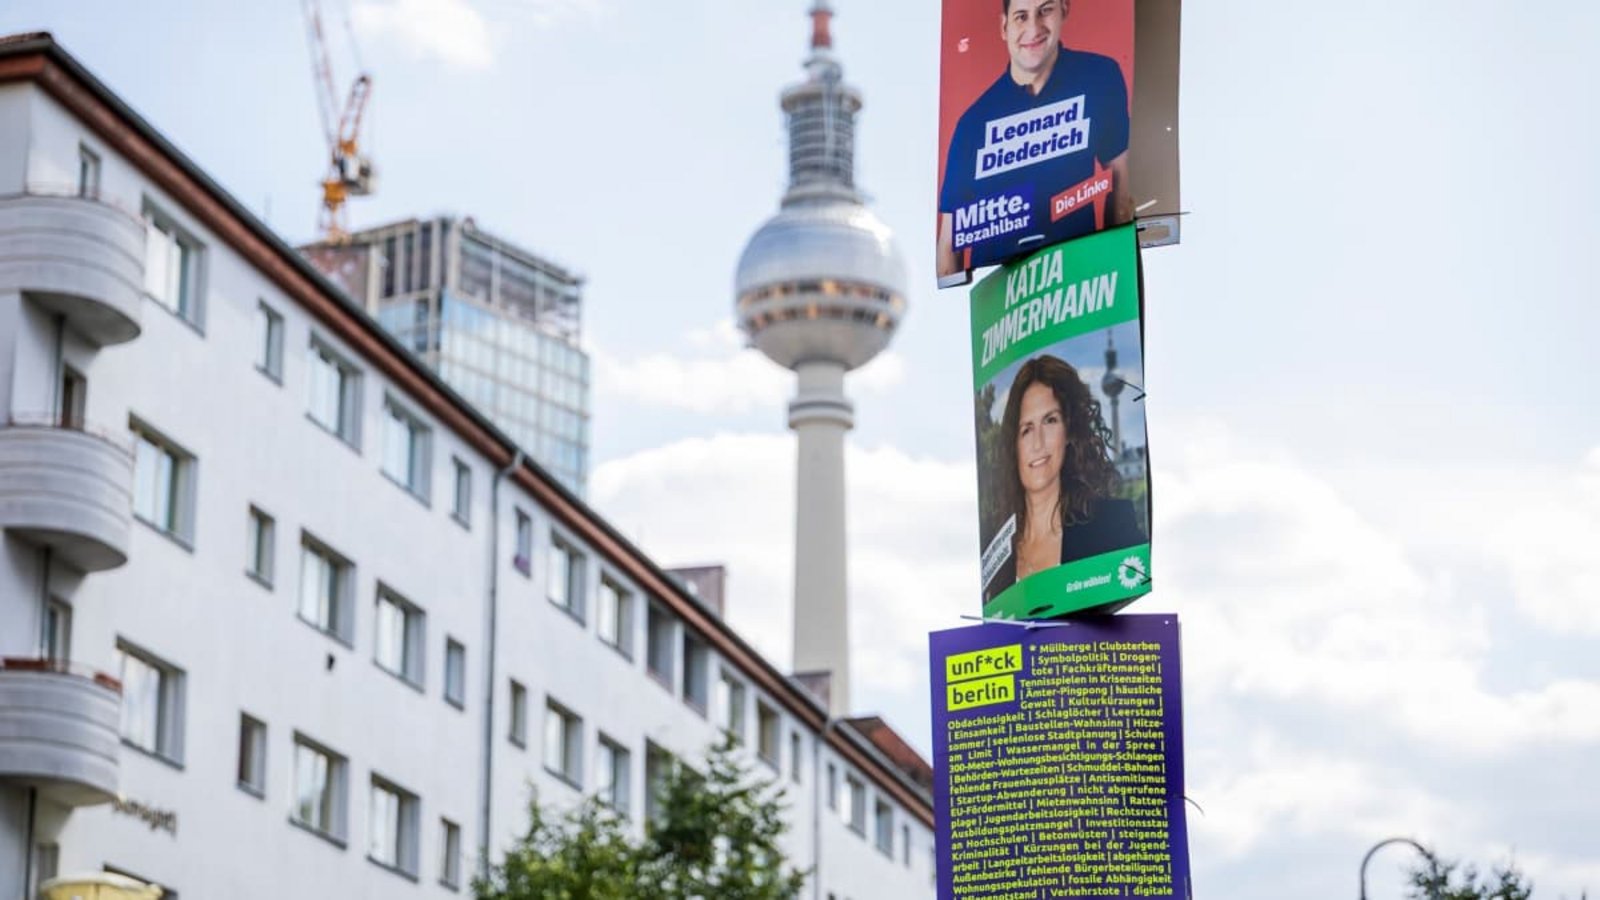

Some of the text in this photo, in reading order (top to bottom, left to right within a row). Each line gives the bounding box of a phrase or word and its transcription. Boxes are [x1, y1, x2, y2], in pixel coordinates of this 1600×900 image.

[991, 102, 1078, 144] Leonard
[982, 128, 1083, 172] Diederich
[1056, 179, 1109, 214] Die Linke
[956, 195, 1030, 231] Mitte.
[956, 216, 1030, 248] Bezahlbar
[1005, 250, 1063, 310] KATJA
[982, 271, 1118, 368] ZIMMERMANN
[1040, 642, 1091, 653] Müllberge
[1100, 641, 1160, 650] Clubsterben
[1120, 653, 1160, 663] Drogen-
[1032, 667, 1053, 676] tote
[1089, 674, 1098, 682] in
[1100, 673, 1162, 683] Krisenzeiten
[954, 682, 1008, 704] berlin
[1116, 684, 1162, 694] häusliche
[1021, 698, 1056, 709] Gewalt
[1035, 708, 1100, 719] Schlaglöcher
[1112, 707, 1163, 716] Leerstand
[954, 726, 1004, 740] Einsamkeit
[1133, 719, 1163, 728] Hitze-
[949, 740, 984, 752] sommer
[993, 733, 1045, 746] seelenlose
[1048, 729, 1116, 740] Stadtplanung
[1125, 729, 1164, 738] Schulen
[968, 749, 992, 760] Limit
[1006, 741, 1080, 754] Wassermangel
[1087, 741, 1096, 750] in
[1102, 740, 1120, 750] der
[1126, 741, 1155, 752] Spree
[950, 782, 991, 795] fehlende
[1078, 784, 1104, 794] nicht
[1108, 784, 1166, 795] abgerufene
[1130, 797, 1167, 806] Ratten-
[952, 818, 976, 829] plage
[1106, 806, 1162, 816] Rechtsruck
[966, 834, 1028, 848] Hochschulen
[1039, 830, 1108, 841] Betonwüsten
[1119, 829, 1168, 840] steigende
[952, 847, 1010, 861] Kriminalität
[1024, 842, 1079, 854] Kürzungen
[1084, 840, 1101, 850] bei
[1106, 840, 1124, 850] der
[1129, 840, 1170, 851] Jugend-
[953, 862, 979, 872] arbeit
[1114, 852, 1170, 862] abgehängte
[954, 868, 1016, 884] Außenbezirke
[1027, 864, 1070, 875] fehlende
[1069, 874, 1102, 884] fossile
[1106, 874, 1172, 884] Abhängigkeit
[1050, 886, 1120, 897] Verkehrstote
[1133, 886, 1172, 896] digitale
